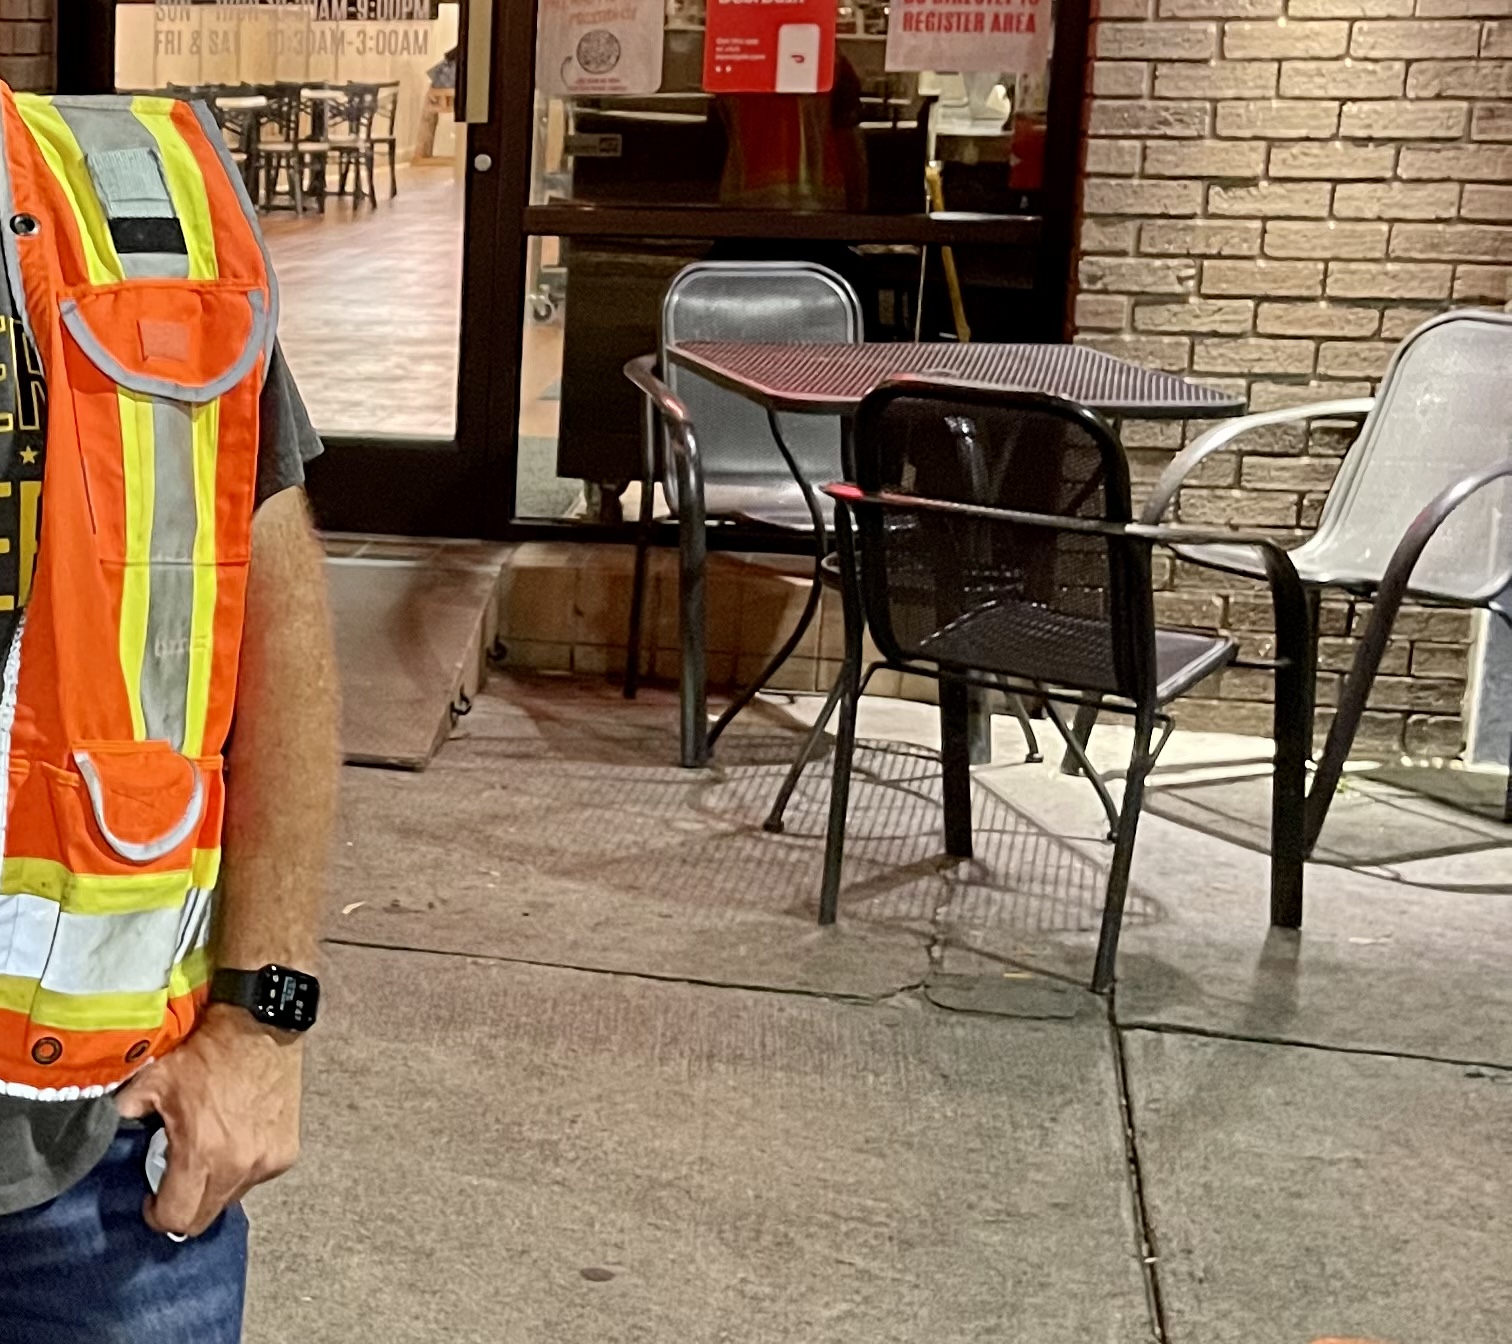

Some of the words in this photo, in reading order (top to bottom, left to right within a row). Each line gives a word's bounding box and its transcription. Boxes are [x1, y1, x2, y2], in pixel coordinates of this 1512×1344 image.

[902, 11, 986, 33] REGISTER
[990, 13, 1036, 33] AREA
[156, 30, 182, 56] FRI
